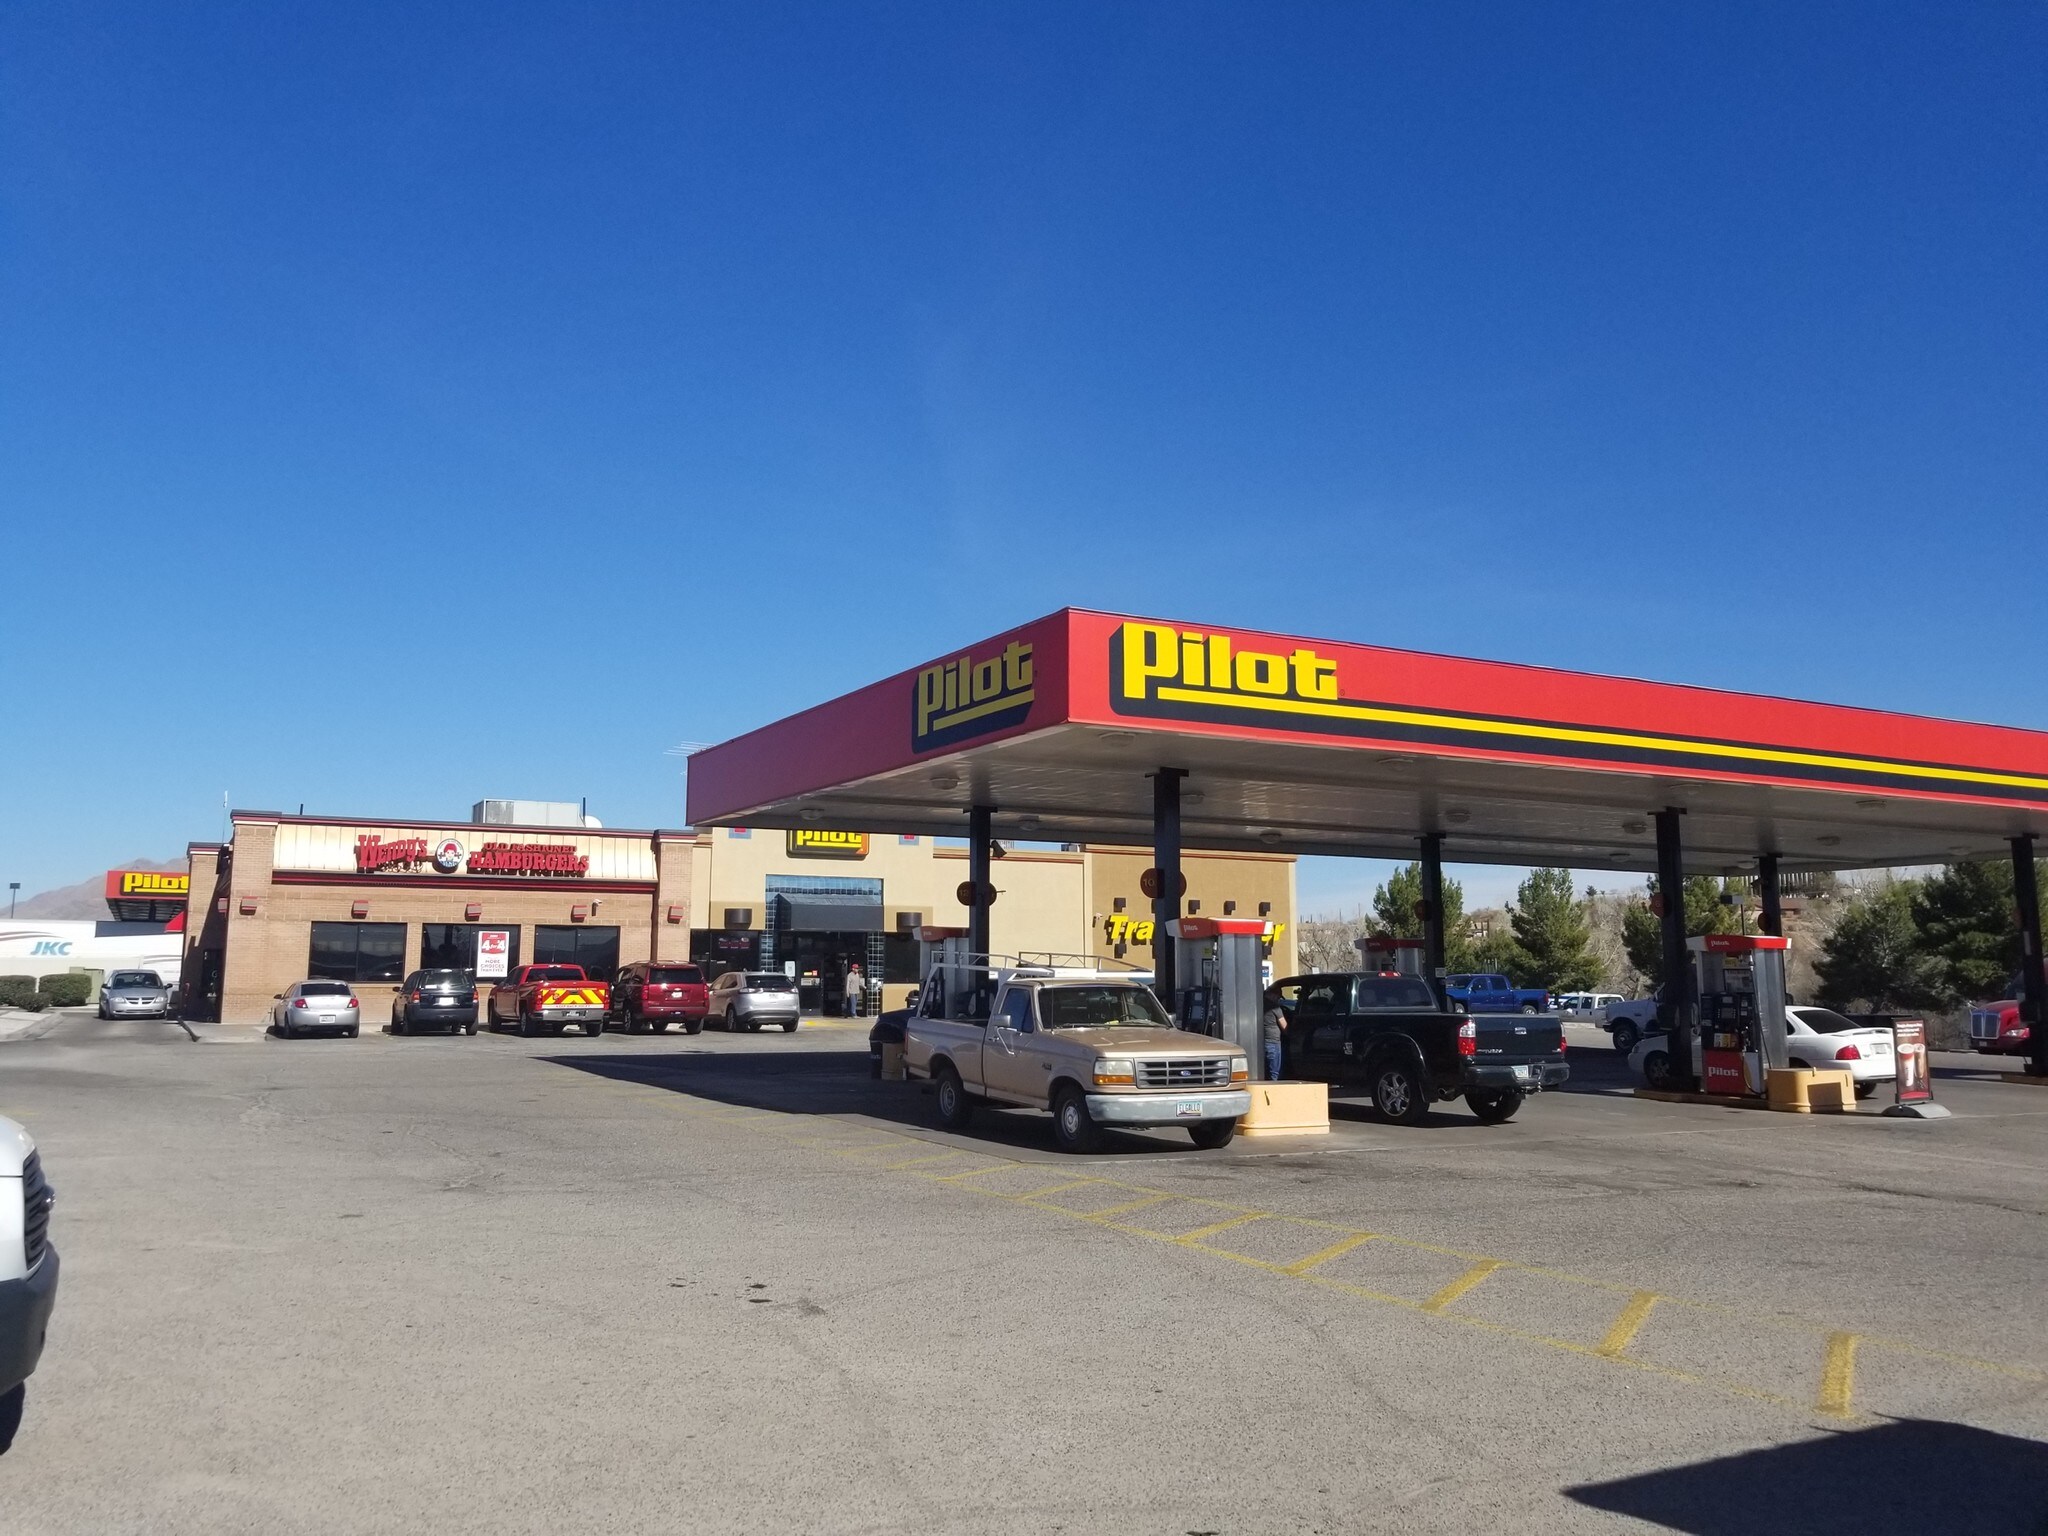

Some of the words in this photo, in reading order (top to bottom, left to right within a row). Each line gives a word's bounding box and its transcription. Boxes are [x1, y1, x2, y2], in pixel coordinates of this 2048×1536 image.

[1123, 622, 1338, 700] Pilot
[917, 640, 1033, 737] Pilot
[483, 842, 508, 851] OLD
[469, 851, 590, 872] HAMBURGERS
[1109, 915, 1156, 940] Tra
[30, 941, 73, 956] JKC
[1708, 1066, 1738, 1077] Pilot
